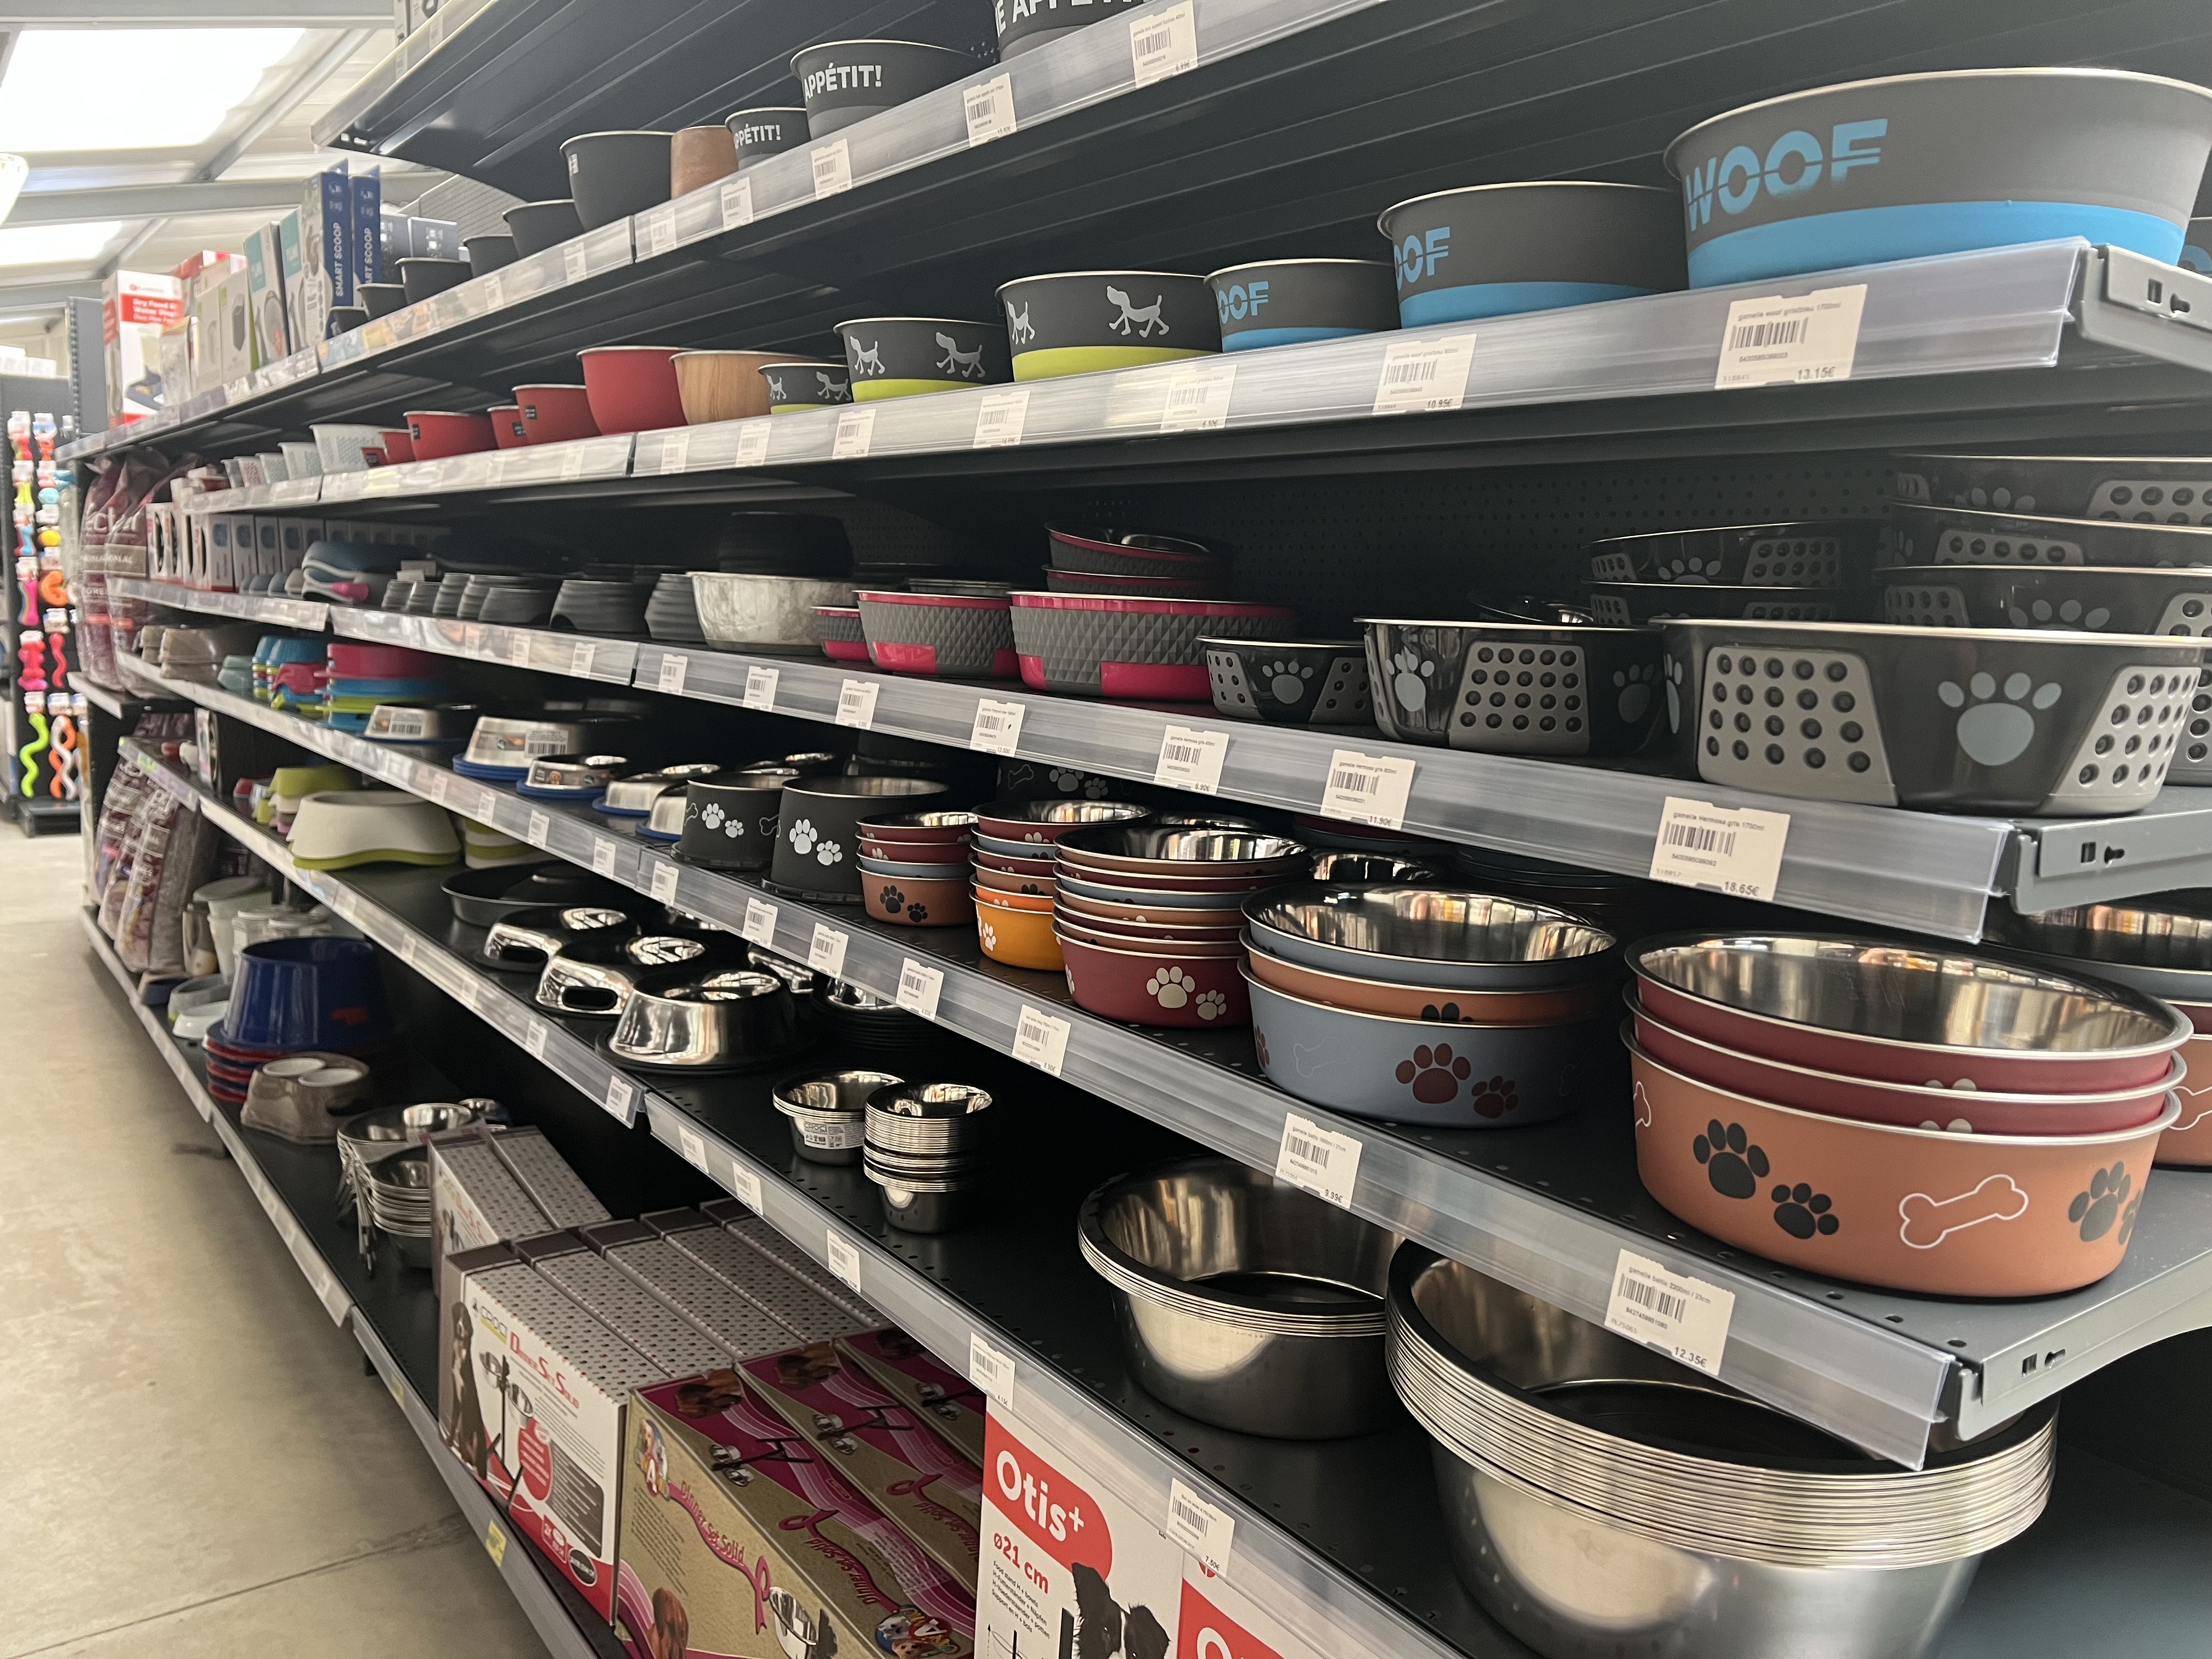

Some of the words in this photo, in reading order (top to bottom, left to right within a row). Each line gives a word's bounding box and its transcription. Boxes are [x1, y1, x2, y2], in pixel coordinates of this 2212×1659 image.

[1685, 118, 1888, 232] WOOF
[332, 222, 342, 260] SCOOP
[364, 227, 373, 264] SCOOP
[335, 261, 344, 298] SMART
[1796, 366, 1835, 380] 13.15€
[1426, 398, 1453, 408] 10.95€
[1194, 783, 1210, 792] 6.90€
[1368, 815, 1392, 827] 11.90€
[1673, 811, 1696, 821] gamelle
[1723, 880, 1759, 896] 18.65€
[1324, 1188, 1342, 1204] 9.99€
[1629, 1266, 1650, 1280] gamelle
[1652, 1275, 1667, 1286] baltic
[1674, 1345, 1707, 1368] 12.35€
[721, 1534, 745, 1565] Solid
[1205, 1555, 1220, 1571] 7.50€
[994, 1561, 1004, 1575] Food
[1005, 1572, 1016, 1587] stand
[1017, 1582, 1020, 1590] H
[1025, 1591, 1038, 1608] bowls
[1024, 1561, 1049, 1594] cm
[992, 1588, 1008, 1609] Support
[1008, 1607, 1014, 1615] en
